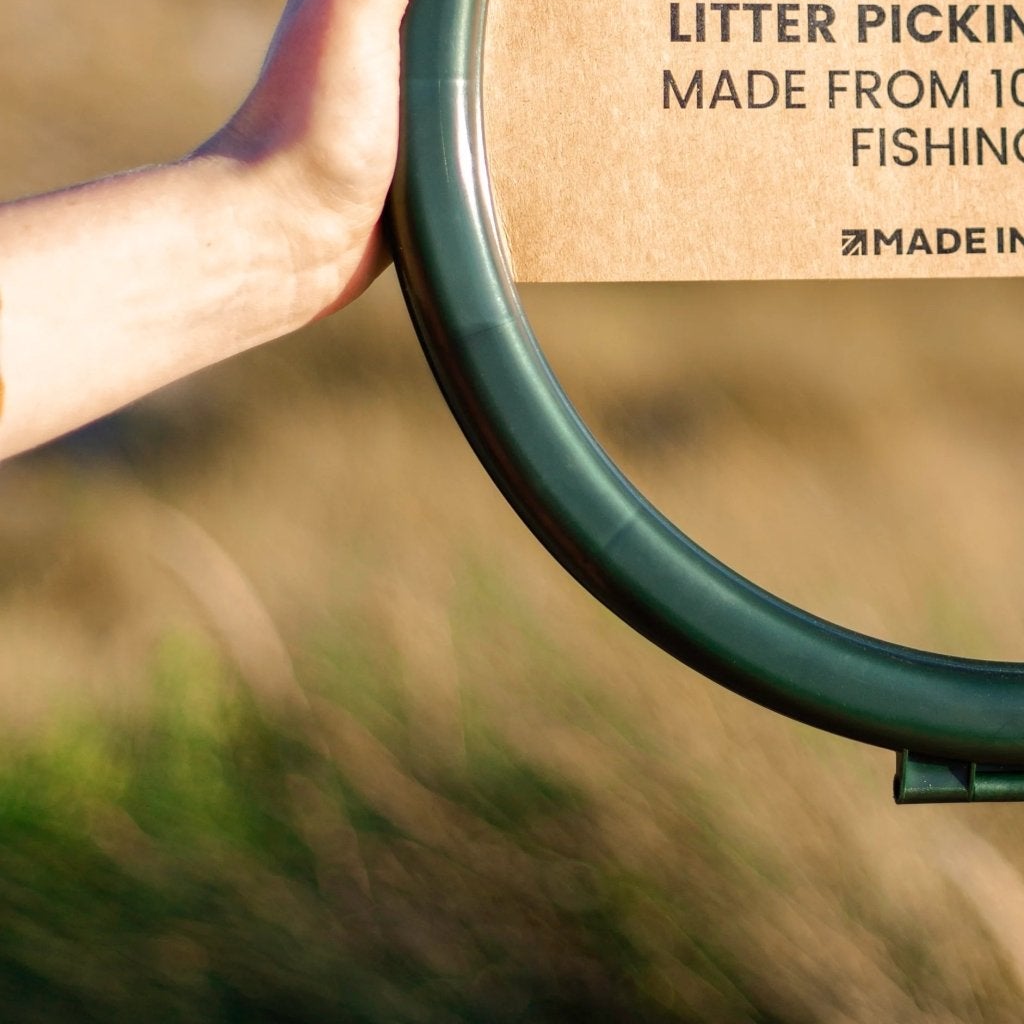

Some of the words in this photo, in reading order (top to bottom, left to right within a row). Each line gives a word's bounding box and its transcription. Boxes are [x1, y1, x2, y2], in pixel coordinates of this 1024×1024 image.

[669, 2, 836, 44] LITTER
[662, 69, 807, 110] MADE
[828, 68, 970, 110] FROM
[873, 227, 987, 257] MADE
